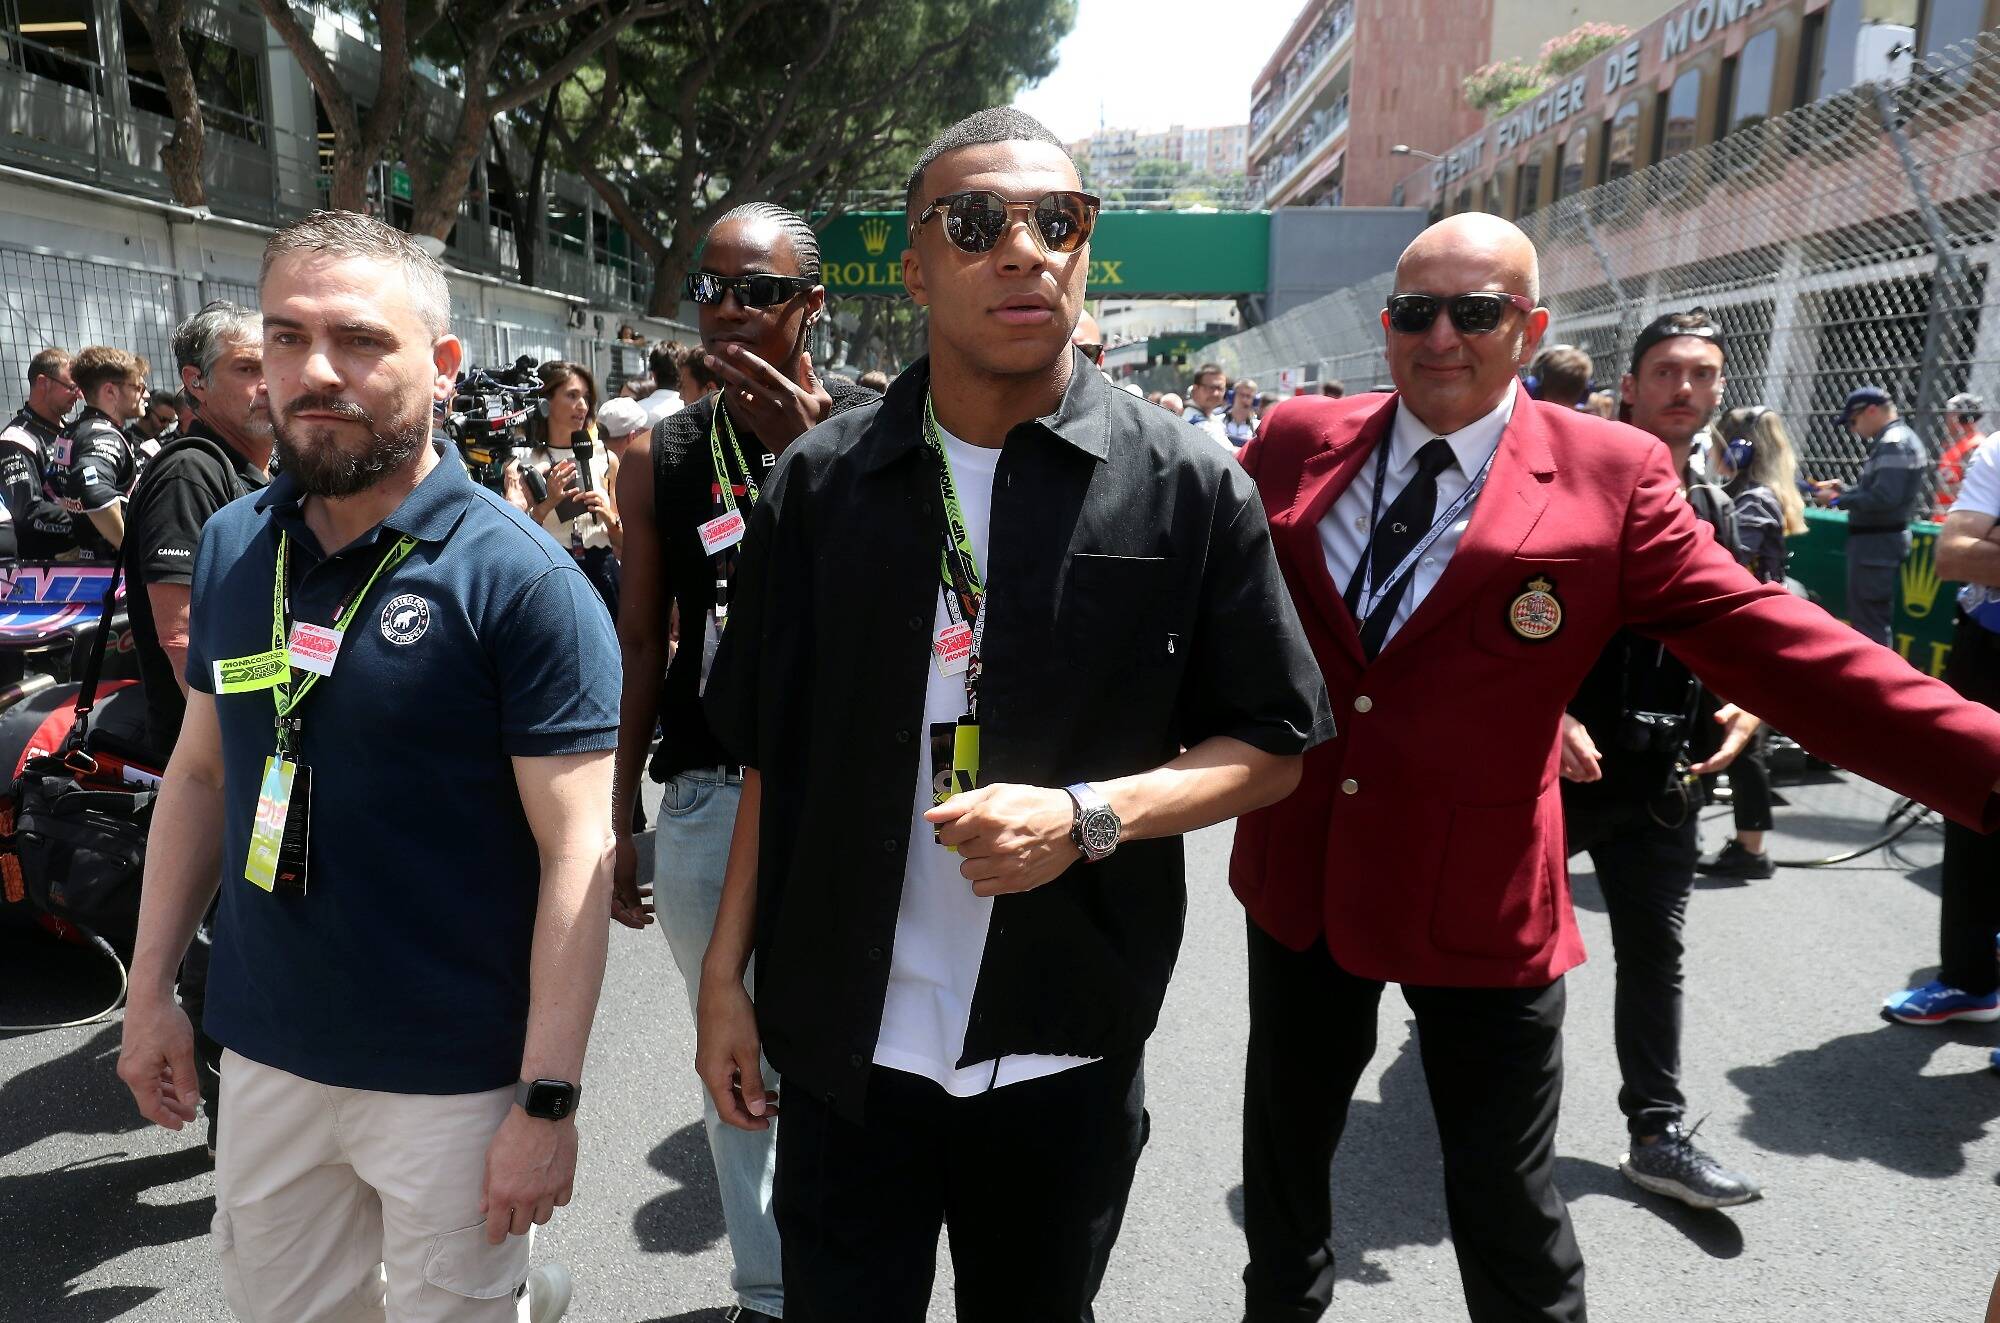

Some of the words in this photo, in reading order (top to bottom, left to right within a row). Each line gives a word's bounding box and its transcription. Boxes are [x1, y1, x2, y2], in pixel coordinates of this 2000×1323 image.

[1430, 137, 1485, 190] CEDIT
[1493, 75, 1586, 157] FONCIER
[1604, 40, 1640, 95] DE
[157, 548, 191, 557] CANAL+
